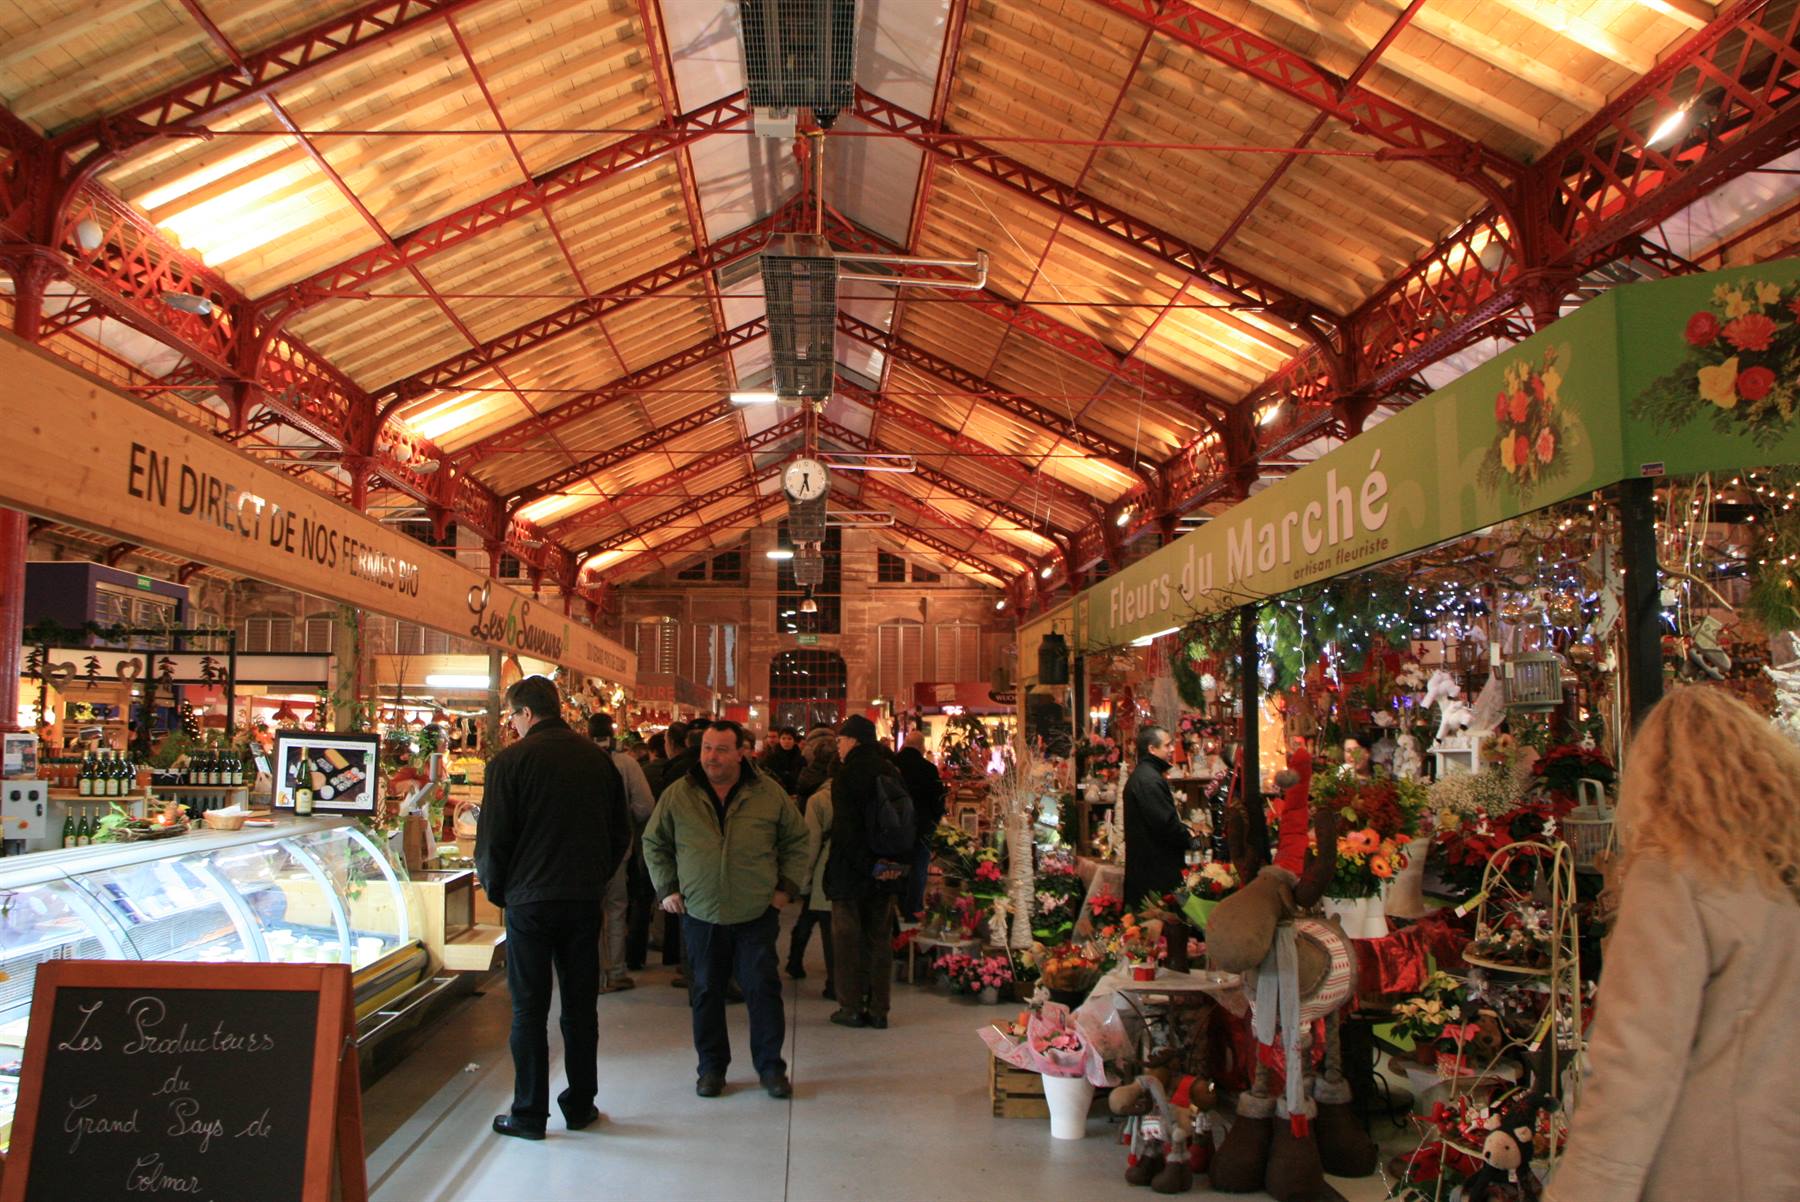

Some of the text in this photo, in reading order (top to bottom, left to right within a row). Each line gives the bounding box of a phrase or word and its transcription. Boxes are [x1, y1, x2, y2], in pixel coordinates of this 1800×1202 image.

[128, 442, 419, 598] EN DIRECT DE NOS FERMES BIO
[1111, 448, 1389, 629] Fleurs du Marché
[1293, 538, 1389, 580] artisan fleuriste
[467, 579, 507, 641] Les
[504, 596, 517, 646] 6
[516, 600, 563, 661] Saveurs
[57, 996, 275, 1055] Les Producteurs
[152, 1065, 192, 1096] du
[64, 1094, 272, 1154] Grand Pays de
[125, 1152, 204, 1194] Colmar
